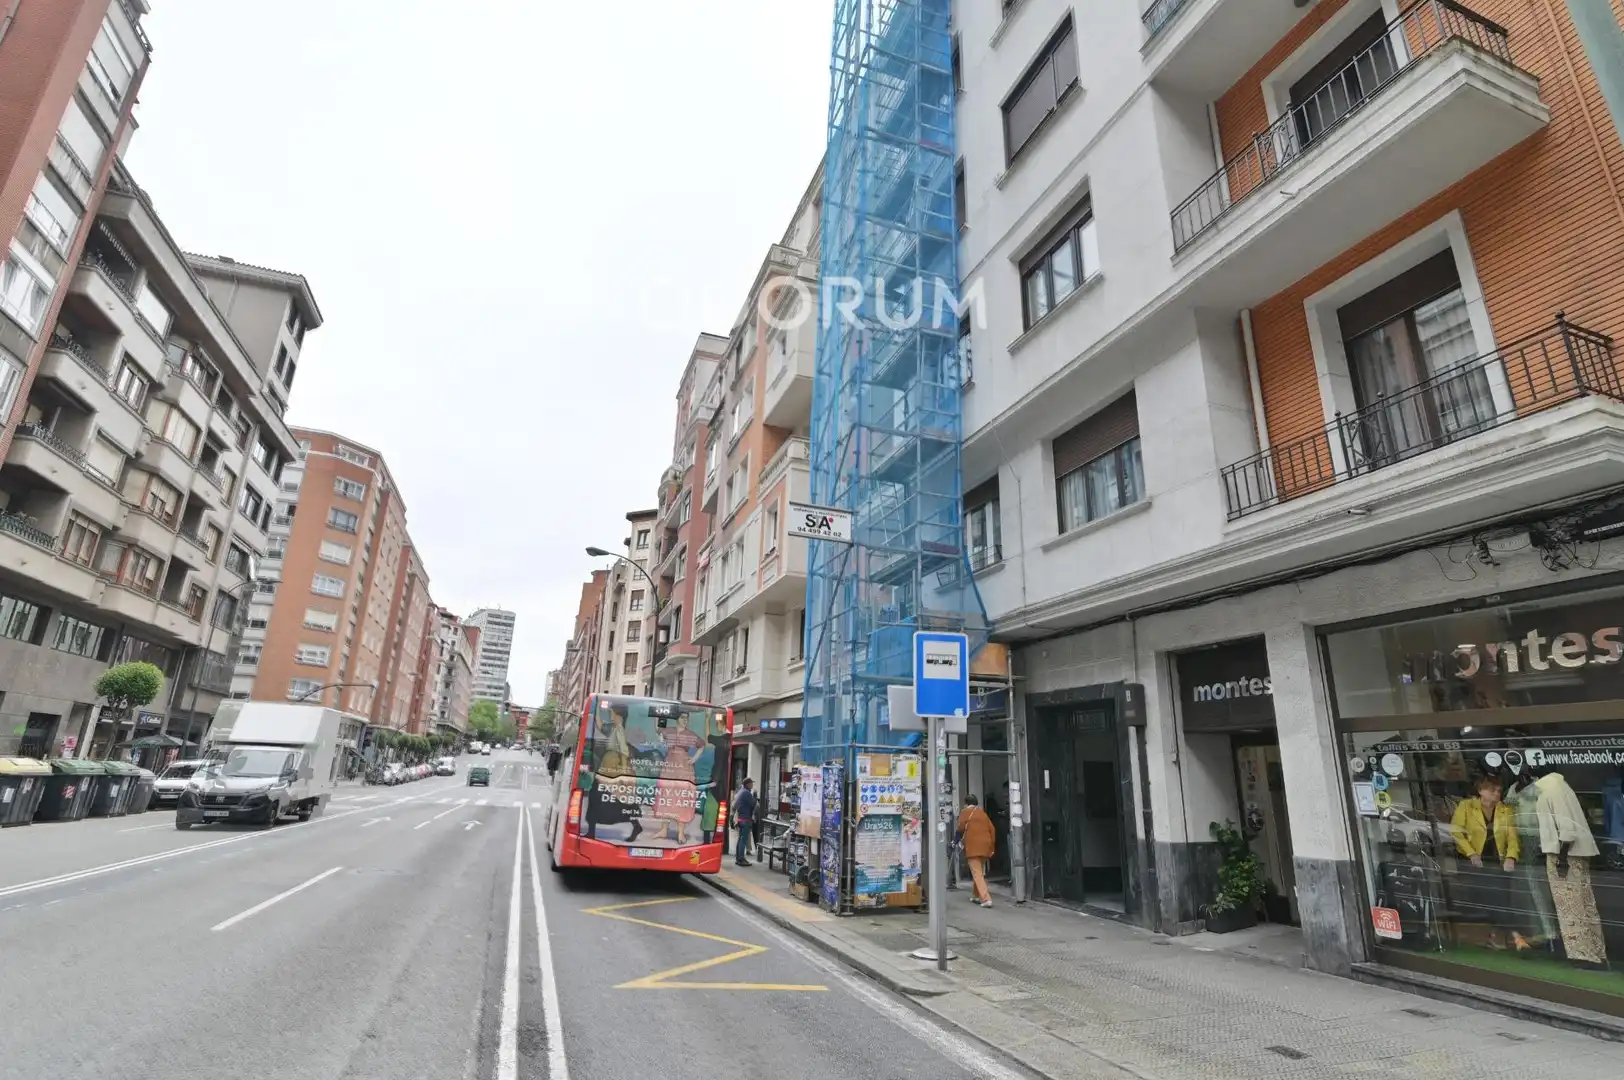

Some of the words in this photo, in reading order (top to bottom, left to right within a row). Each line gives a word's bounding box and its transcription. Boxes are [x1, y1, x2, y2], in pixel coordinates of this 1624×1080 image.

[1193, 675, 1274, 702] montes
[630, 758, 653, 767] HOTEL
[597, 783, 662, 796] EXPOSICIÓN
[664, 788, 673, 797] Y
[675, 789, 707, 799] VENTA
[601, 794, 616, 803] DE
[619, 795, 656, 807] OBRAS
[659, 797, 673, 807] DE
[675, 798, 701, 809] ARTE
